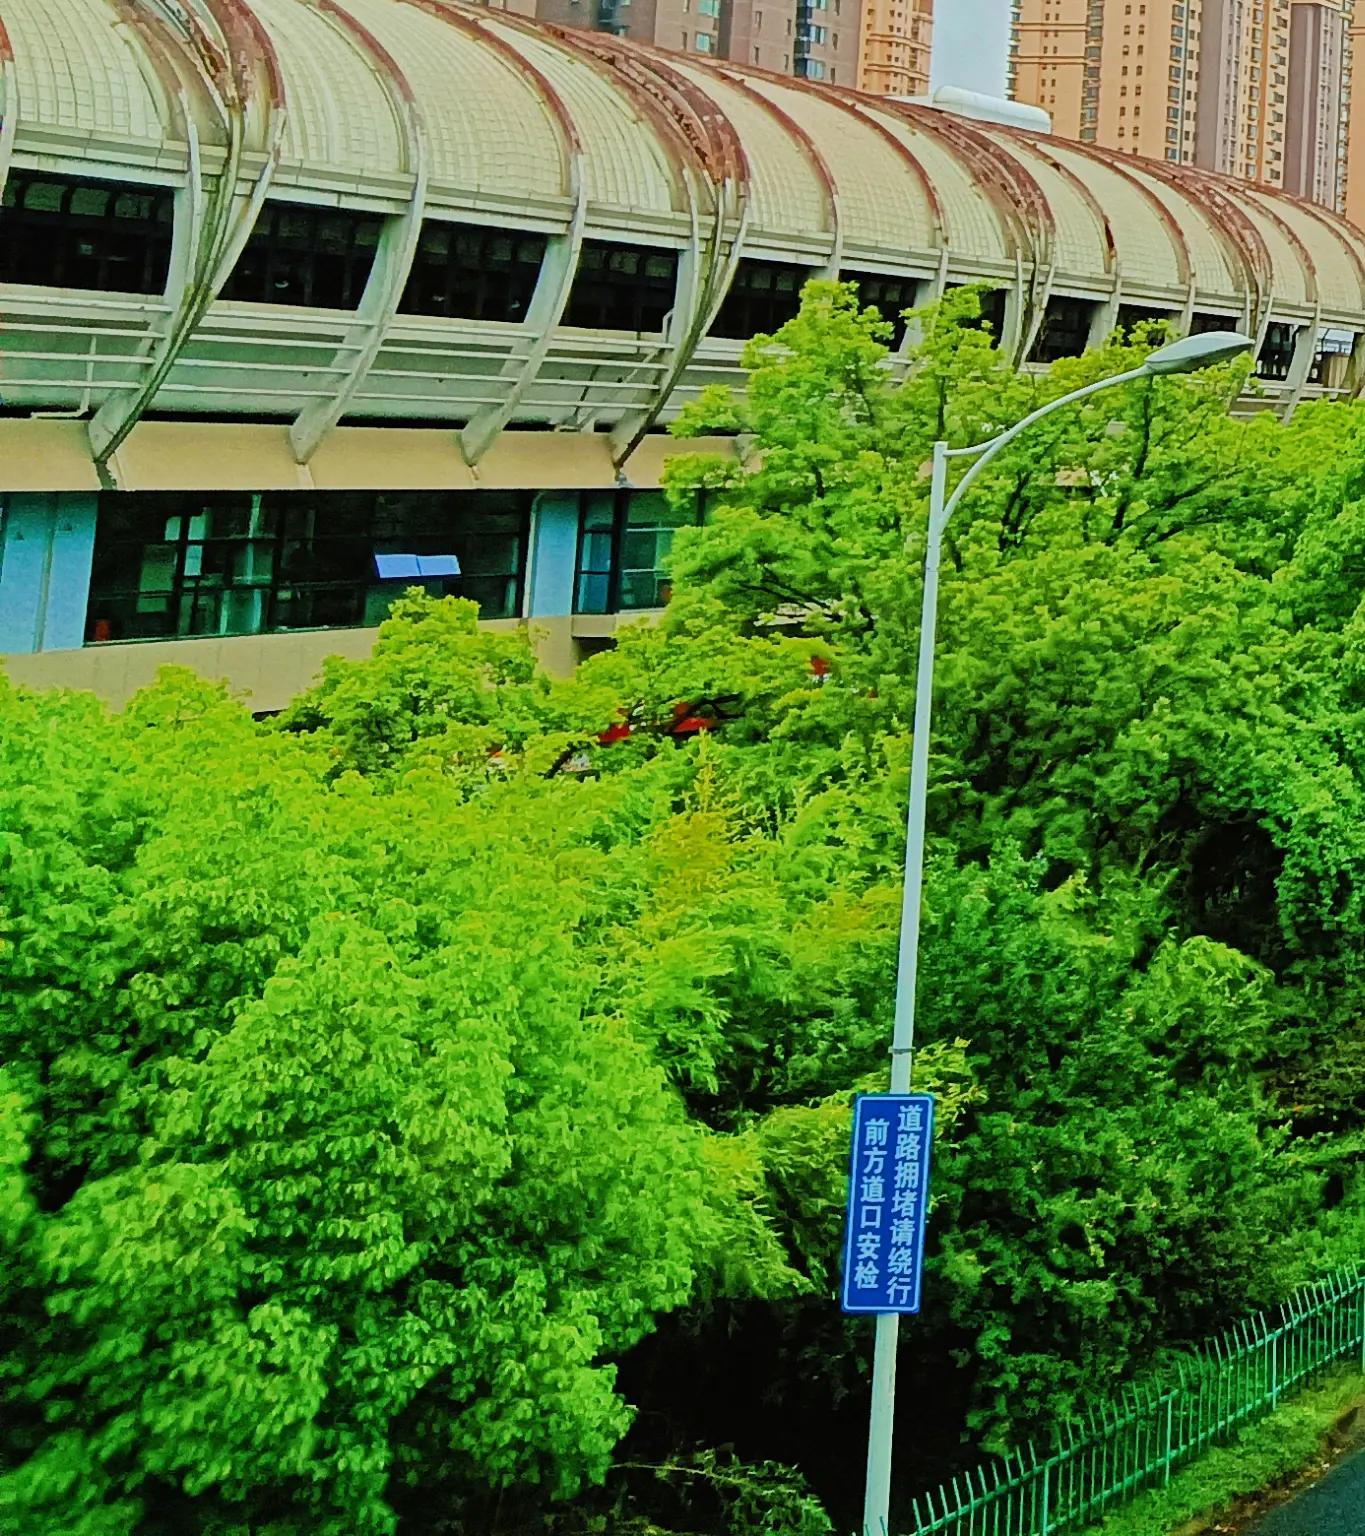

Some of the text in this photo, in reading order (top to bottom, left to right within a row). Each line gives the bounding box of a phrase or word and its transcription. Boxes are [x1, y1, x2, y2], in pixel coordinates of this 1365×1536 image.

[854, 1118, 890, 1290] 前方道口安检
[886, 1104, 924, 1305] 道路拥堵请绕行
